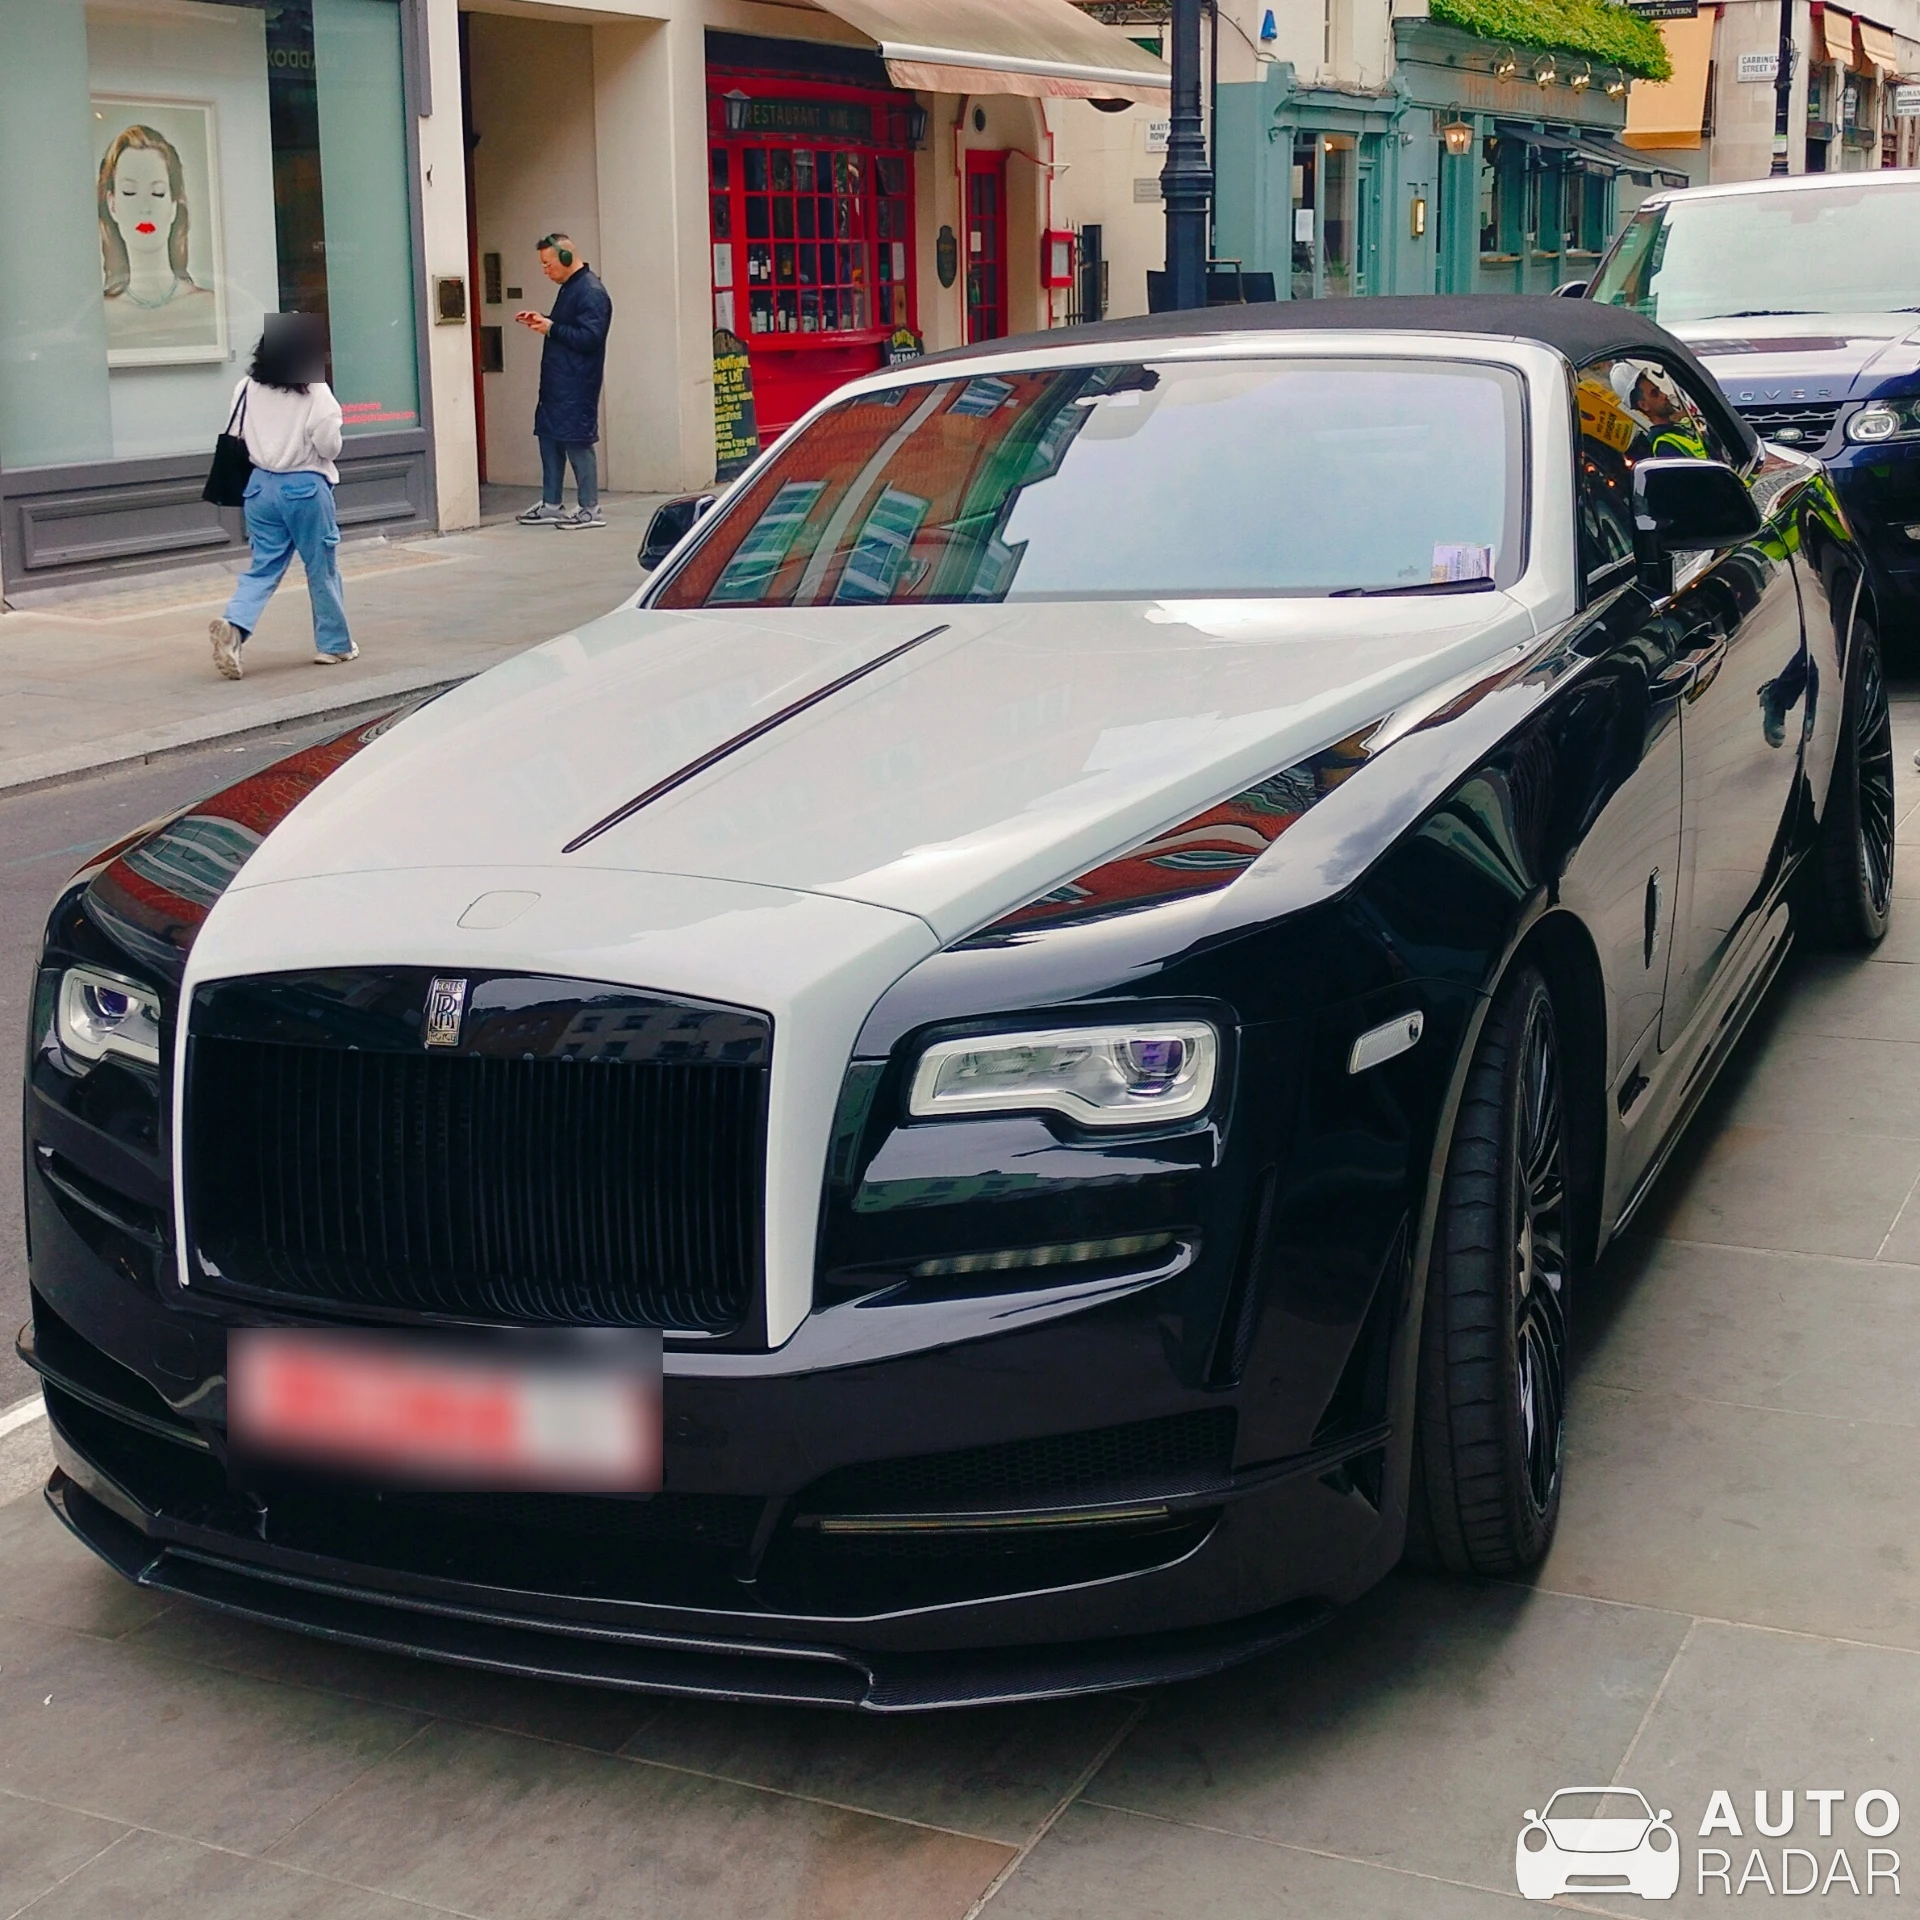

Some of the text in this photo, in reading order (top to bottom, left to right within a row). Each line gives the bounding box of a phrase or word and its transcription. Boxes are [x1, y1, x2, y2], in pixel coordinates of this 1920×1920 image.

[1661, 7, 1693, 16] TAVERN
[1742, 55, 1779, 65] CARRINGT
[1742, 64, 1777, 73] STREET W
[1150, 123, 1171, 132] MAYF
[1149, 132, 1166, 140] ROW
[729, 368, 744, 383] LIST
